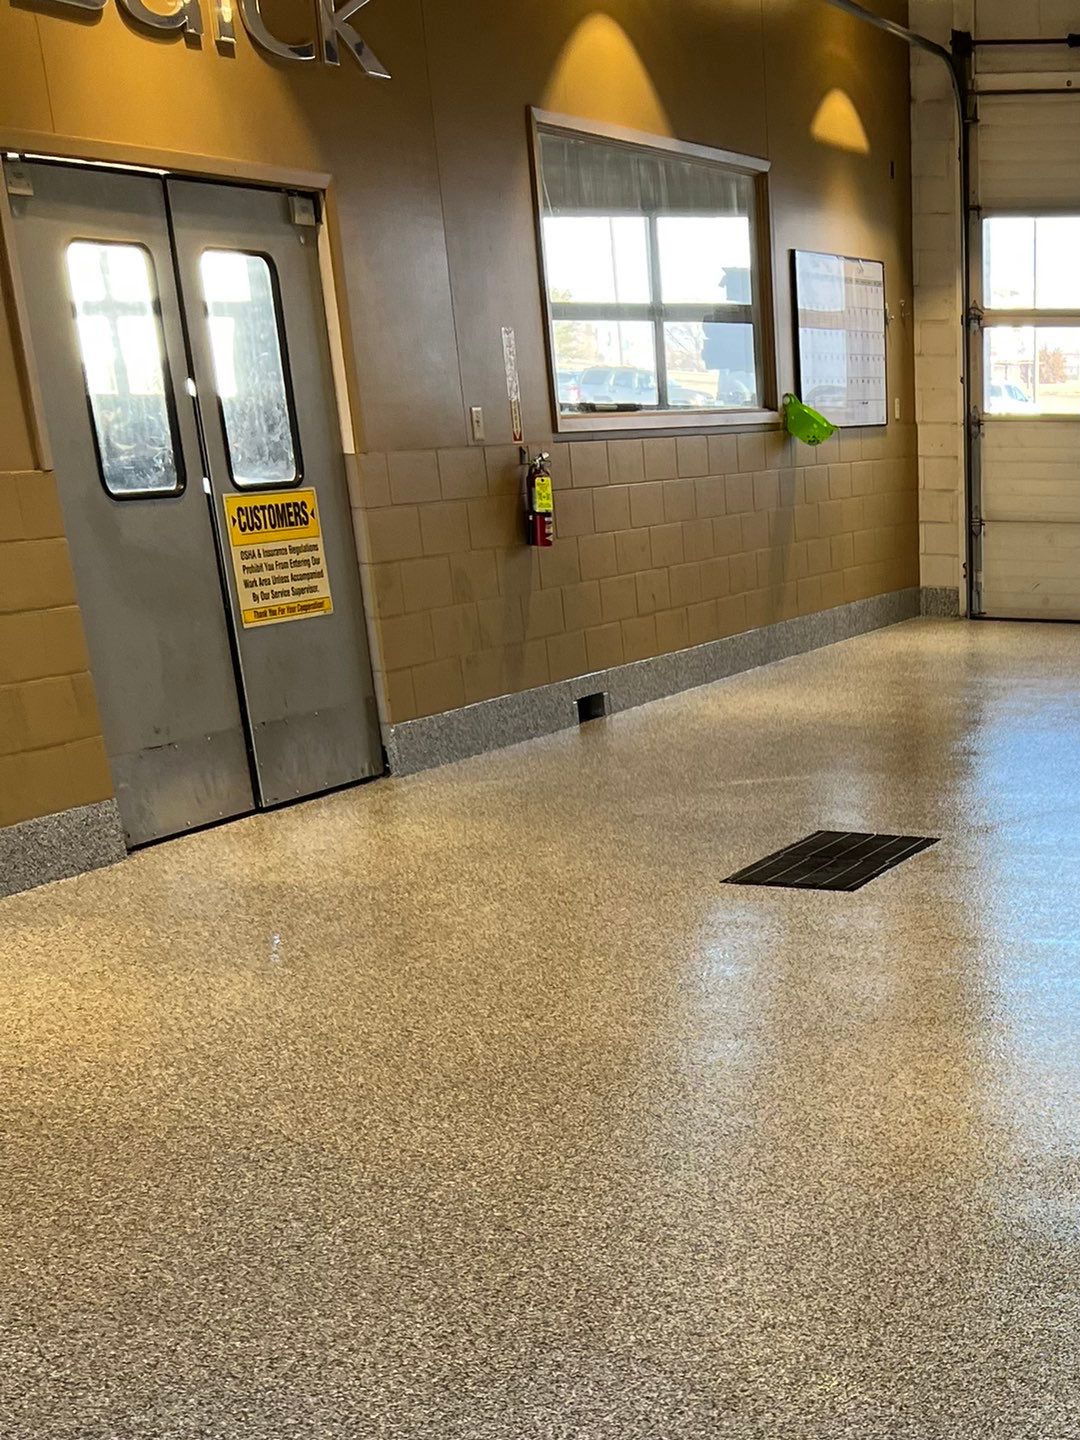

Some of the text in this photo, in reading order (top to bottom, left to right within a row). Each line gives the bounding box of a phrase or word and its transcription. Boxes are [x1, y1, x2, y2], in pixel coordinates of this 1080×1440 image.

[236, 500, 309, 532] CUSTOMERS
[240, 544, 319, 561] OSHA & Insurance Regulations
[242, 556, 321, 575] Prohibit You From Entering Our
[243, 569, 324, 589] Work Area Unless Accompanied
[252, 592, 260, 604] By
[260, 591, 270, 601] Our
[271, 589, 291, 599] Service
[253, 610, 268, 619] Thank
[268, 608, 277, 617] You
[277, 607, 286, 615] For
[286, 605, 297, 614] Your
